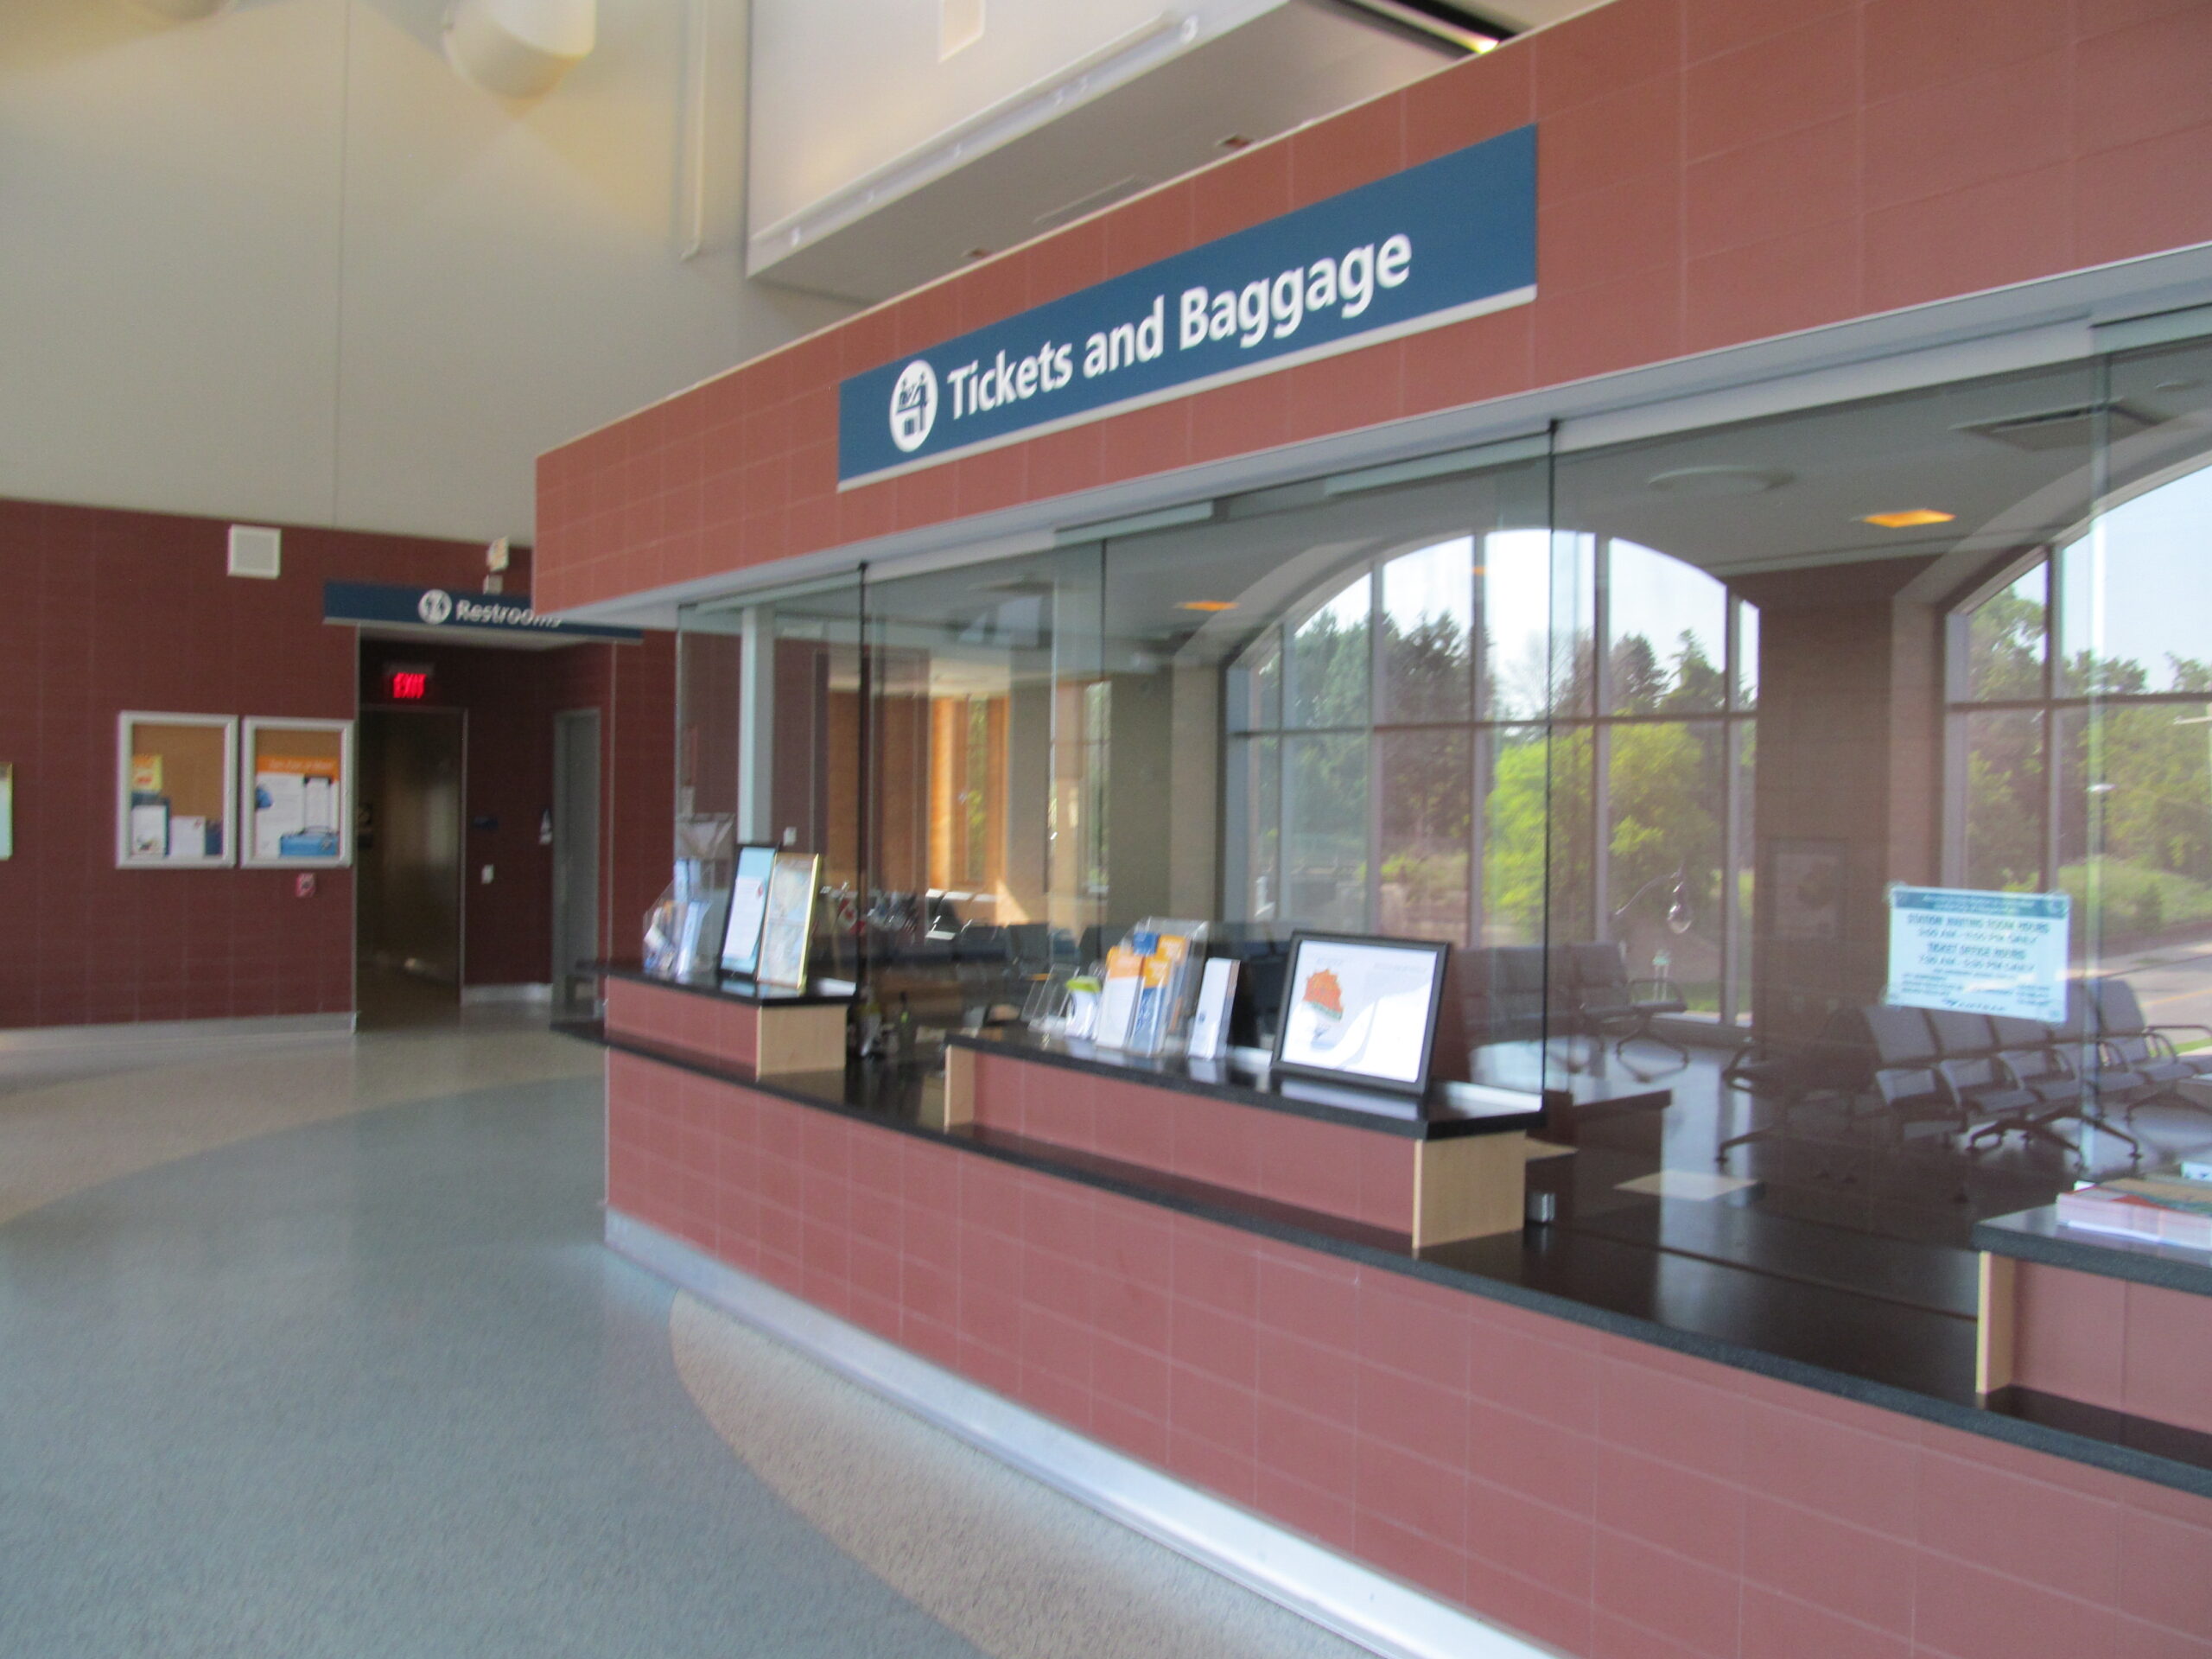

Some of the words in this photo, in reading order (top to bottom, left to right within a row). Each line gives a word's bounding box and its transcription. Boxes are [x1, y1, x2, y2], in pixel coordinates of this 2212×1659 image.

[947, 342, 1073, 420] Tickets
[1084, 296, 1165, 378] and
[1180, 234, 1412, 350] Baggage
